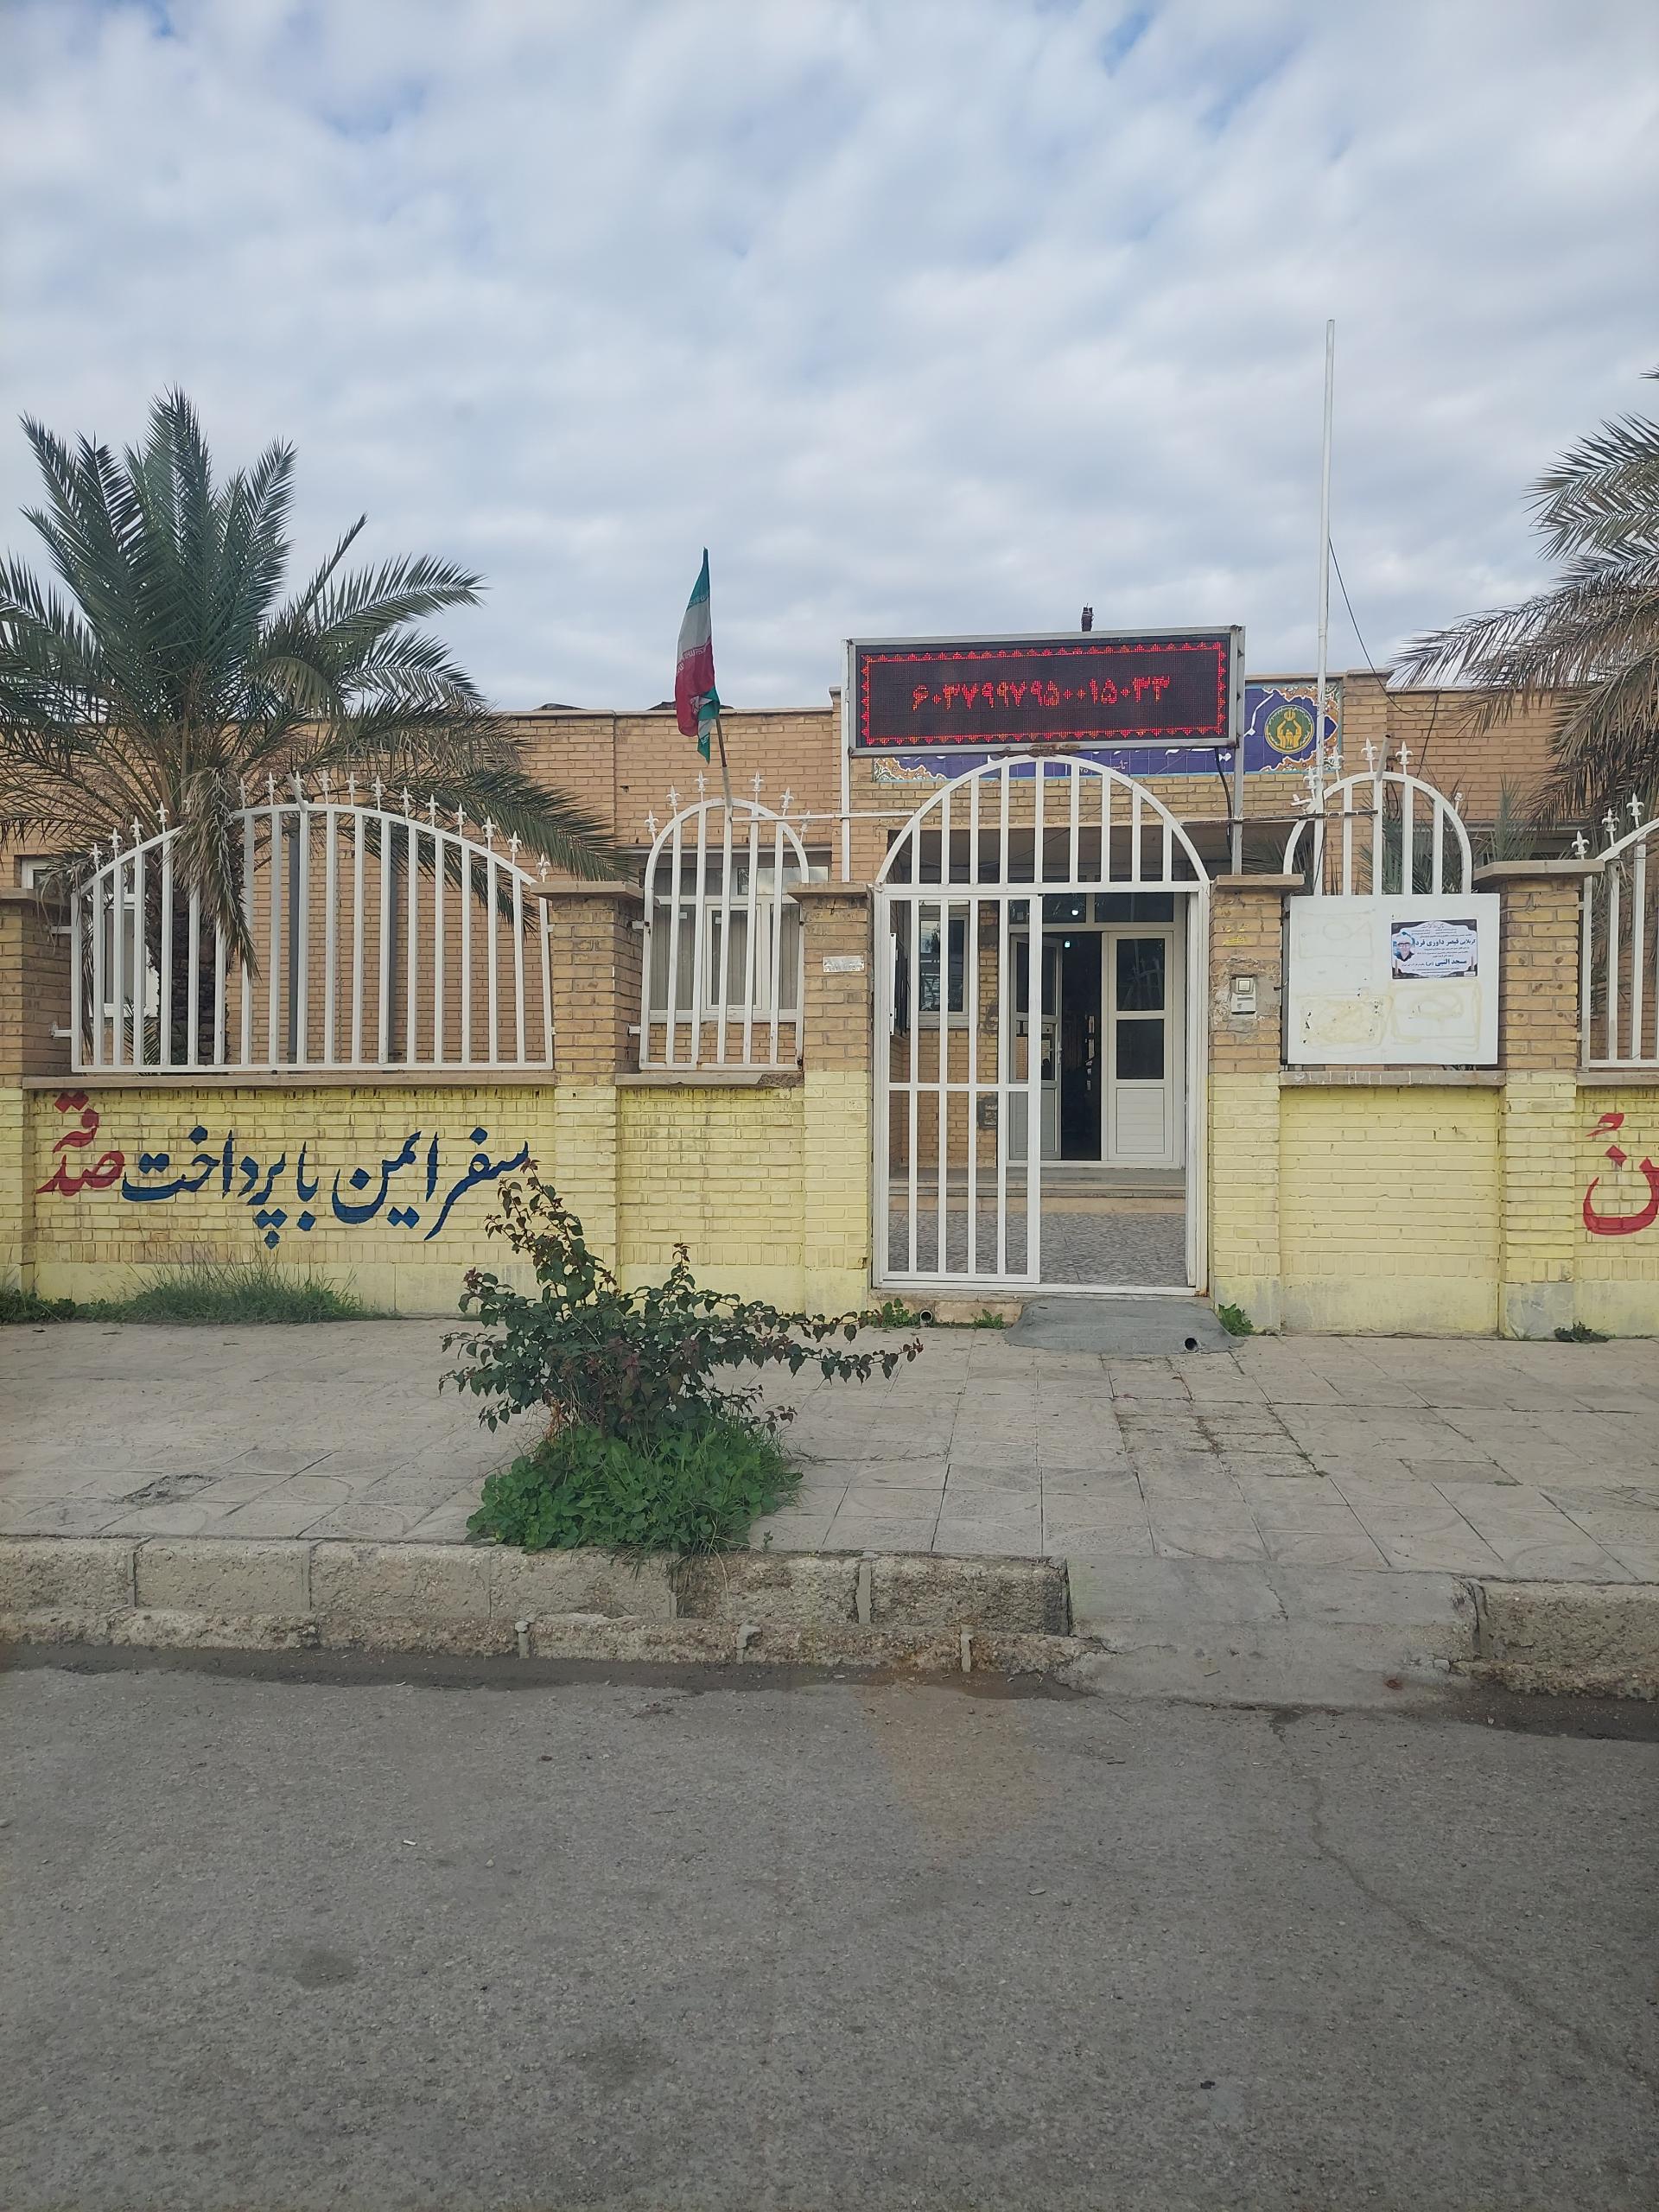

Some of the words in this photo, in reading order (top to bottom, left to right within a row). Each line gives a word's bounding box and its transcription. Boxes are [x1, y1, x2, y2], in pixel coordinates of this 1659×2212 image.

[1415, 938, 1426, 948] فرد
[1427, 938, 1445, 947] داوری
[122, 1125, 287, 1249] پرداخت
[296, 1141, 319, 1231] با
[332, 1130, 439, 1225] ایمن
[424, 1126, 530, 1241] سفر
